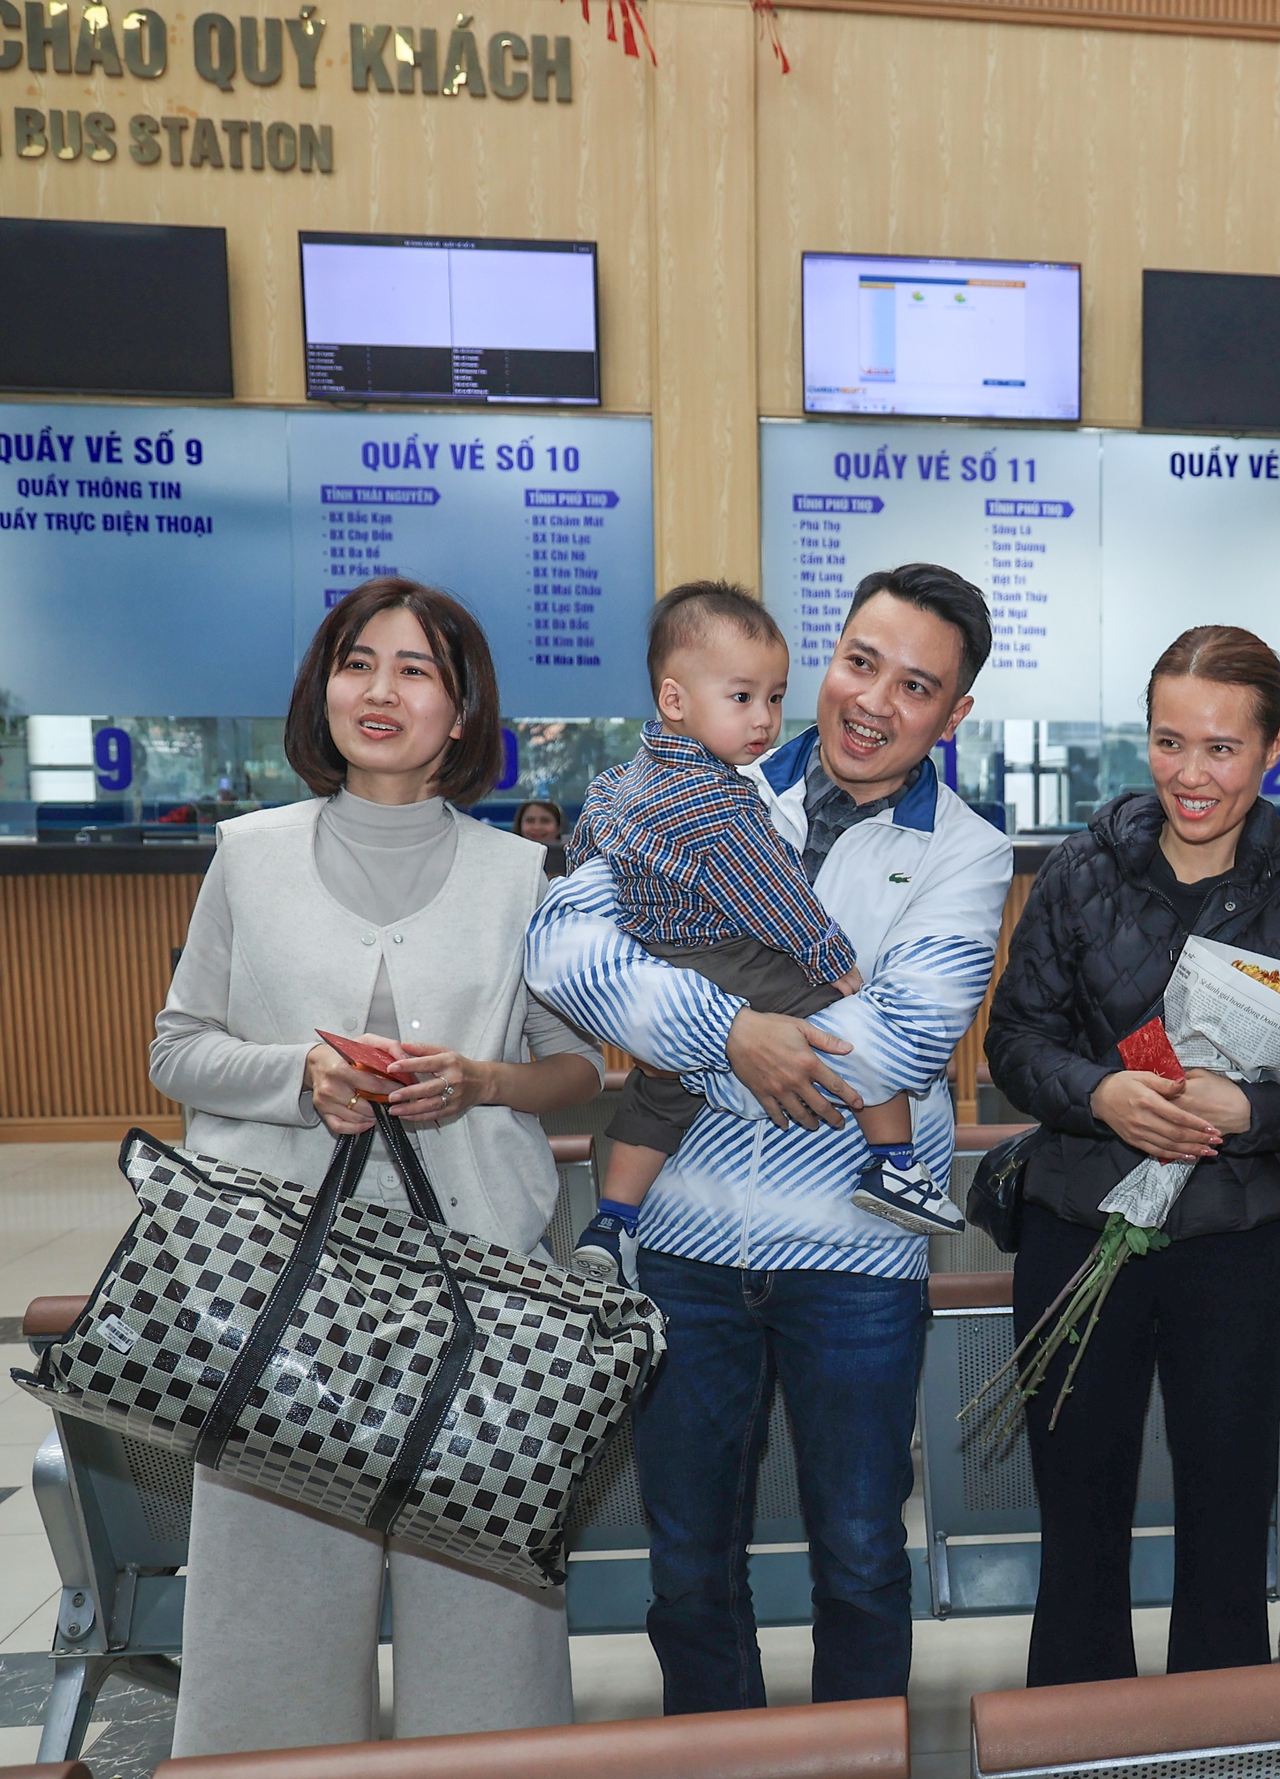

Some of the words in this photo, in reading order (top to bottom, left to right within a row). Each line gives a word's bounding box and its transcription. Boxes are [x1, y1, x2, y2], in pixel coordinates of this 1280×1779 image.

[193, 6, 327, 92] QUÝ
[350, 12, 574, 104] KHÁCH
[14, 107, 117, 162] BUS
[128, 114, 333, 174] STATION
[85, 431, 123, 463] VÉ
[134, 429, 175, 465] SỐ
[185, 438, 203, 466] 9
[450, 438, 484, 470] VÉ
[496, 435, 534, 471] SỐ
[546, 446, 580, 472] 10
[918, 450, 950, 482] VÉ
[961, 447, 997, 483] SỐ
[1008, 458, 1037, 483] 11
[1248, 449, 1279, 480] VÉ
[76, 477, 143, 499] THÔNG
[149, 480, 182, 500] TIN
[45, 511, 96, 534] TRỰC
[102, 510, 149, 536] ĐIỆN
[156, 515, 212, 537] THOẠI
[94, 727, 133, 791] 9
